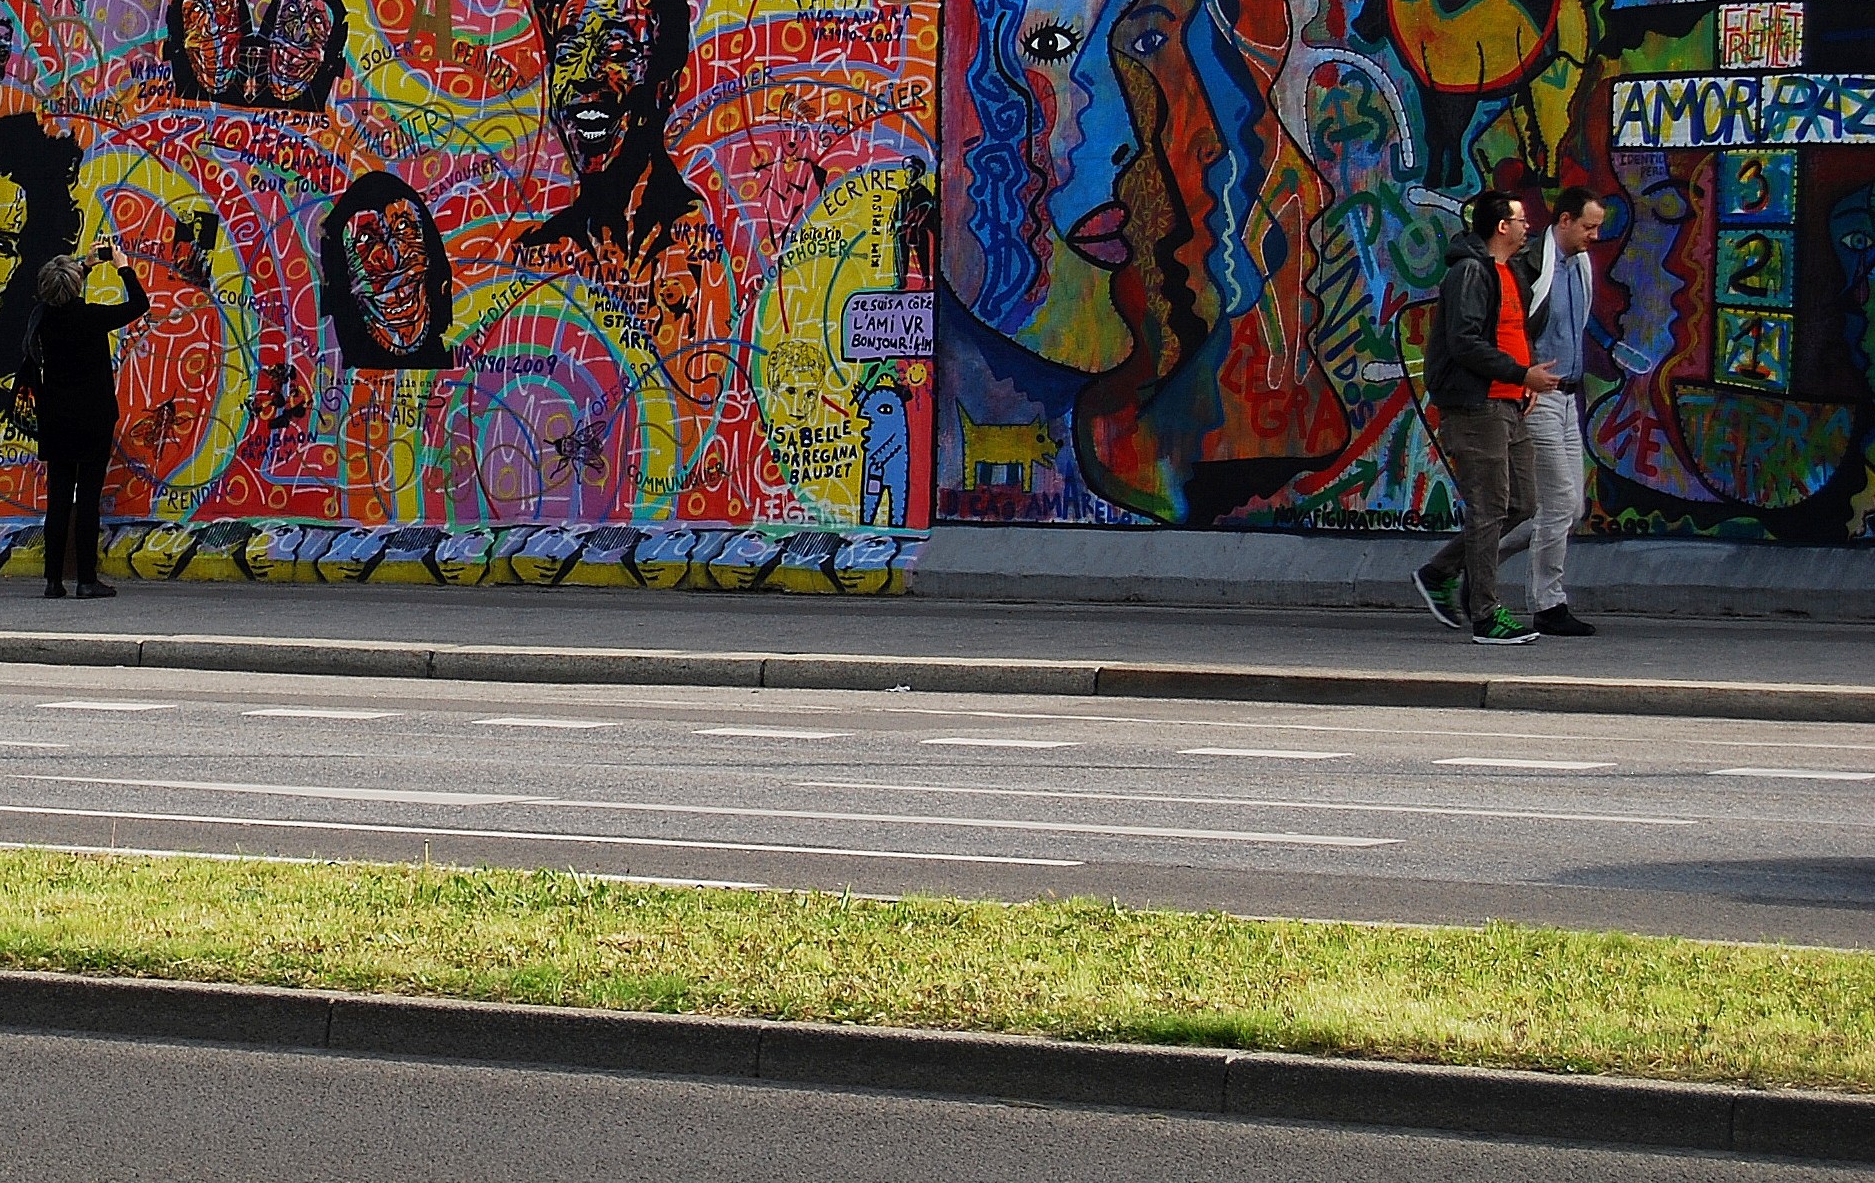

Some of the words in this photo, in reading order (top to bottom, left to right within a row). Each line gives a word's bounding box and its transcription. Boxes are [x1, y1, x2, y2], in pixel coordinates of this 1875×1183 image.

[1613, 78, 1758, 147] AMOR
[1736, 158, 1771, 213] 3
[1726, 232, 1774, 298] 2
